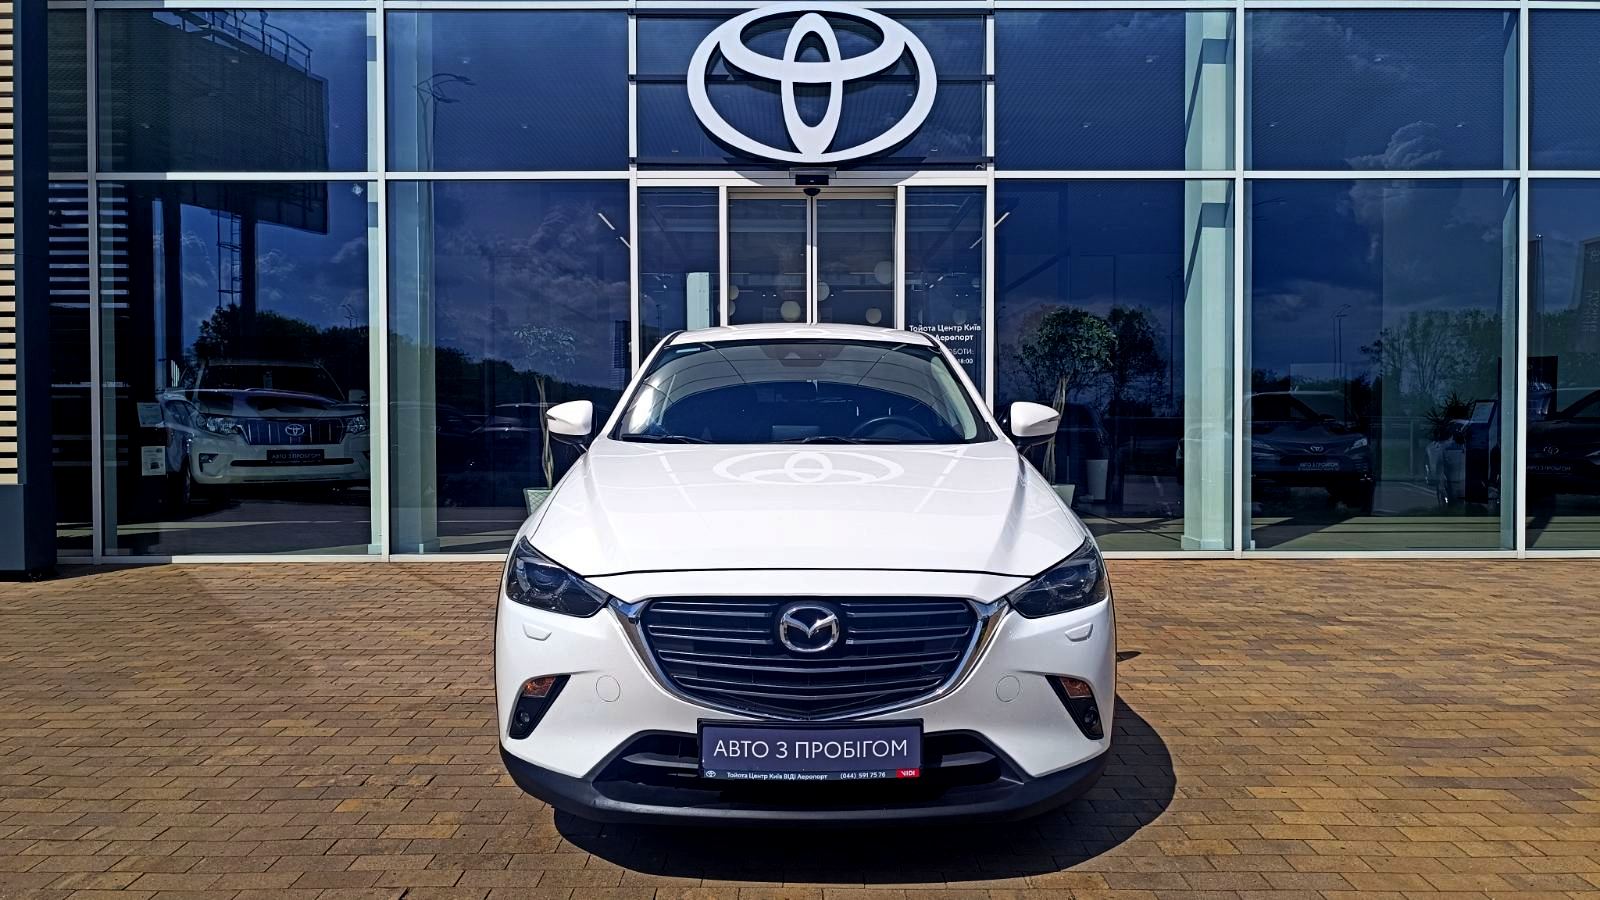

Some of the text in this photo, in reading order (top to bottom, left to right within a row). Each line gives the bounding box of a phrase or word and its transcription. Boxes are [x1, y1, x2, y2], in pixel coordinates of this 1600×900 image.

[938, 325, 962, 333] Центр
[713, 739, 769, 759] АВТО
[795, 739, 908, 759] ПРОБІГОМ
[726, 771, 748, 779] Тойота
[748, 772, 768, 780] Центр
[797, 773, 828, 781] Аеропорт
[840, 772, 857, 780] (044)
